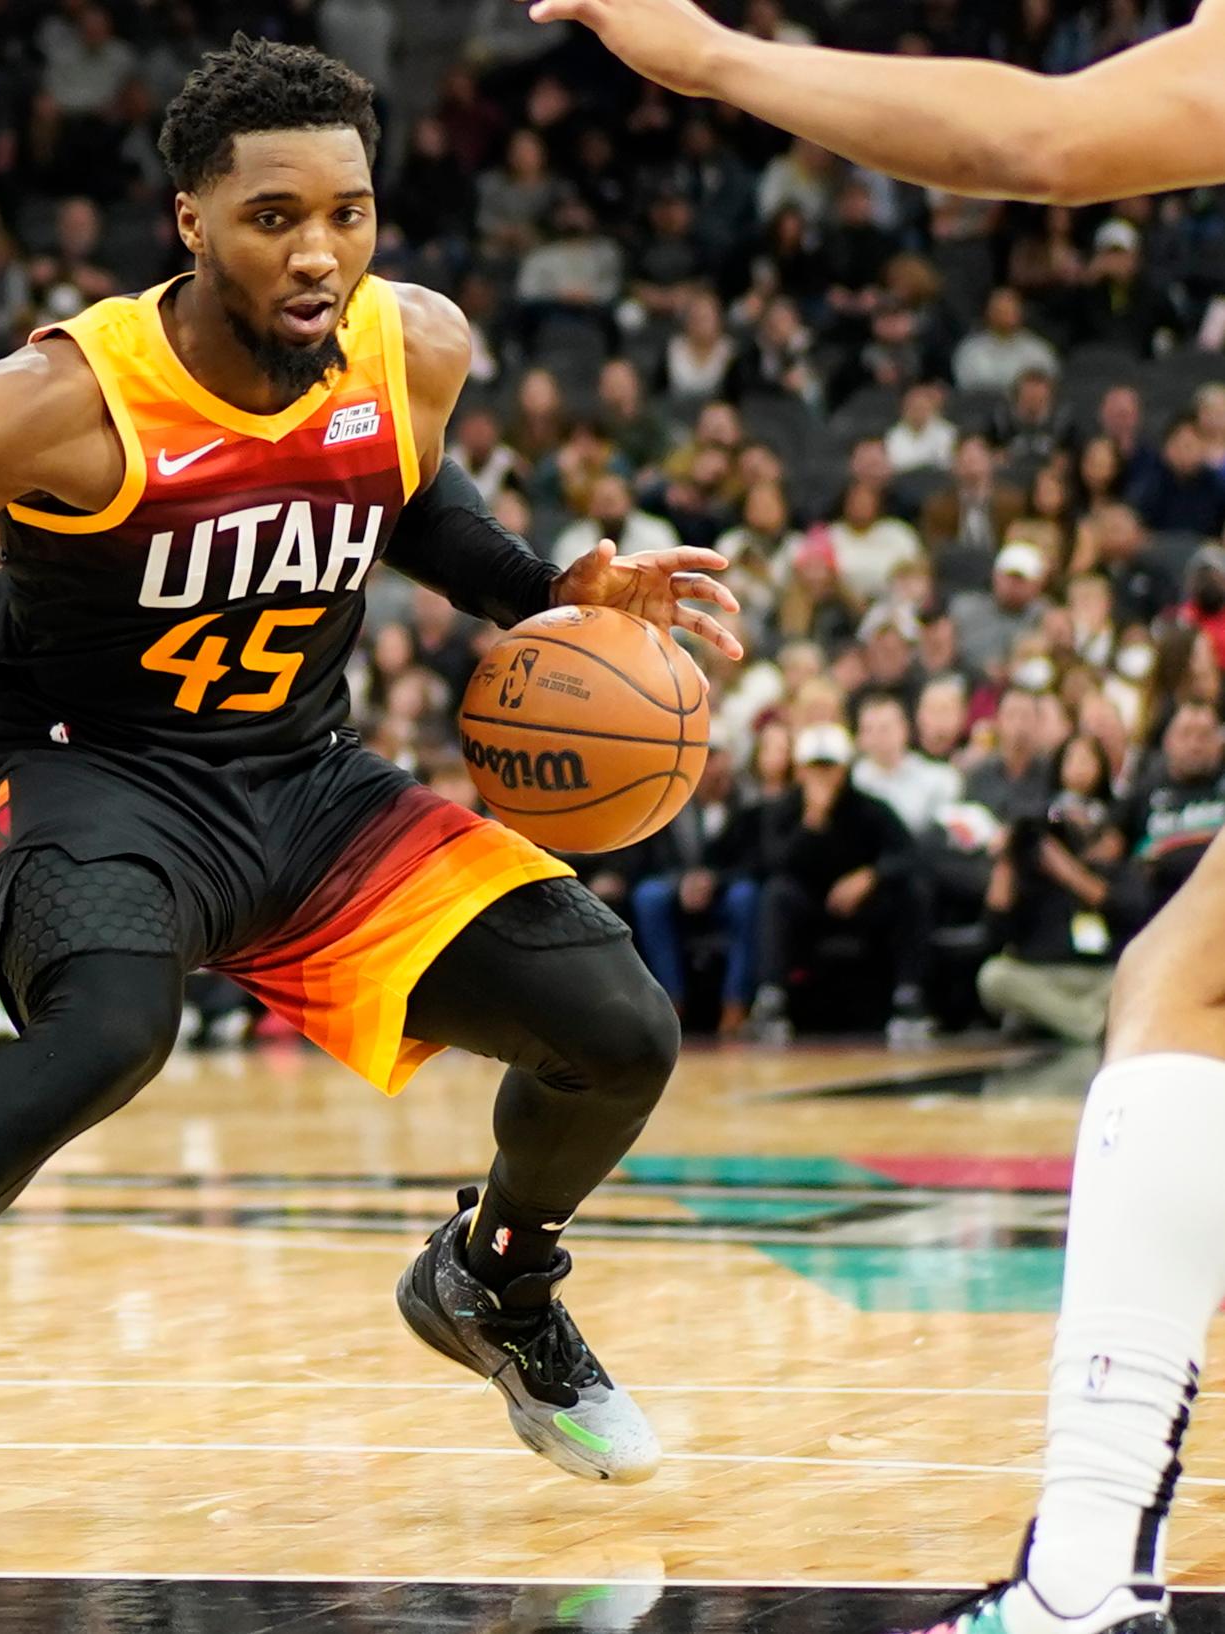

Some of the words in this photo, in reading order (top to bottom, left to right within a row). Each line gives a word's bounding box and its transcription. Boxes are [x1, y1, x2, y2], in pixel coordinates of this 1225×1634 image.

[329, 412, 344, 440] 5
[345, 420, 375, 437] FIGHT
[138, 501, 384, 609] UTAH
[141, 607, 327, 714] 45
